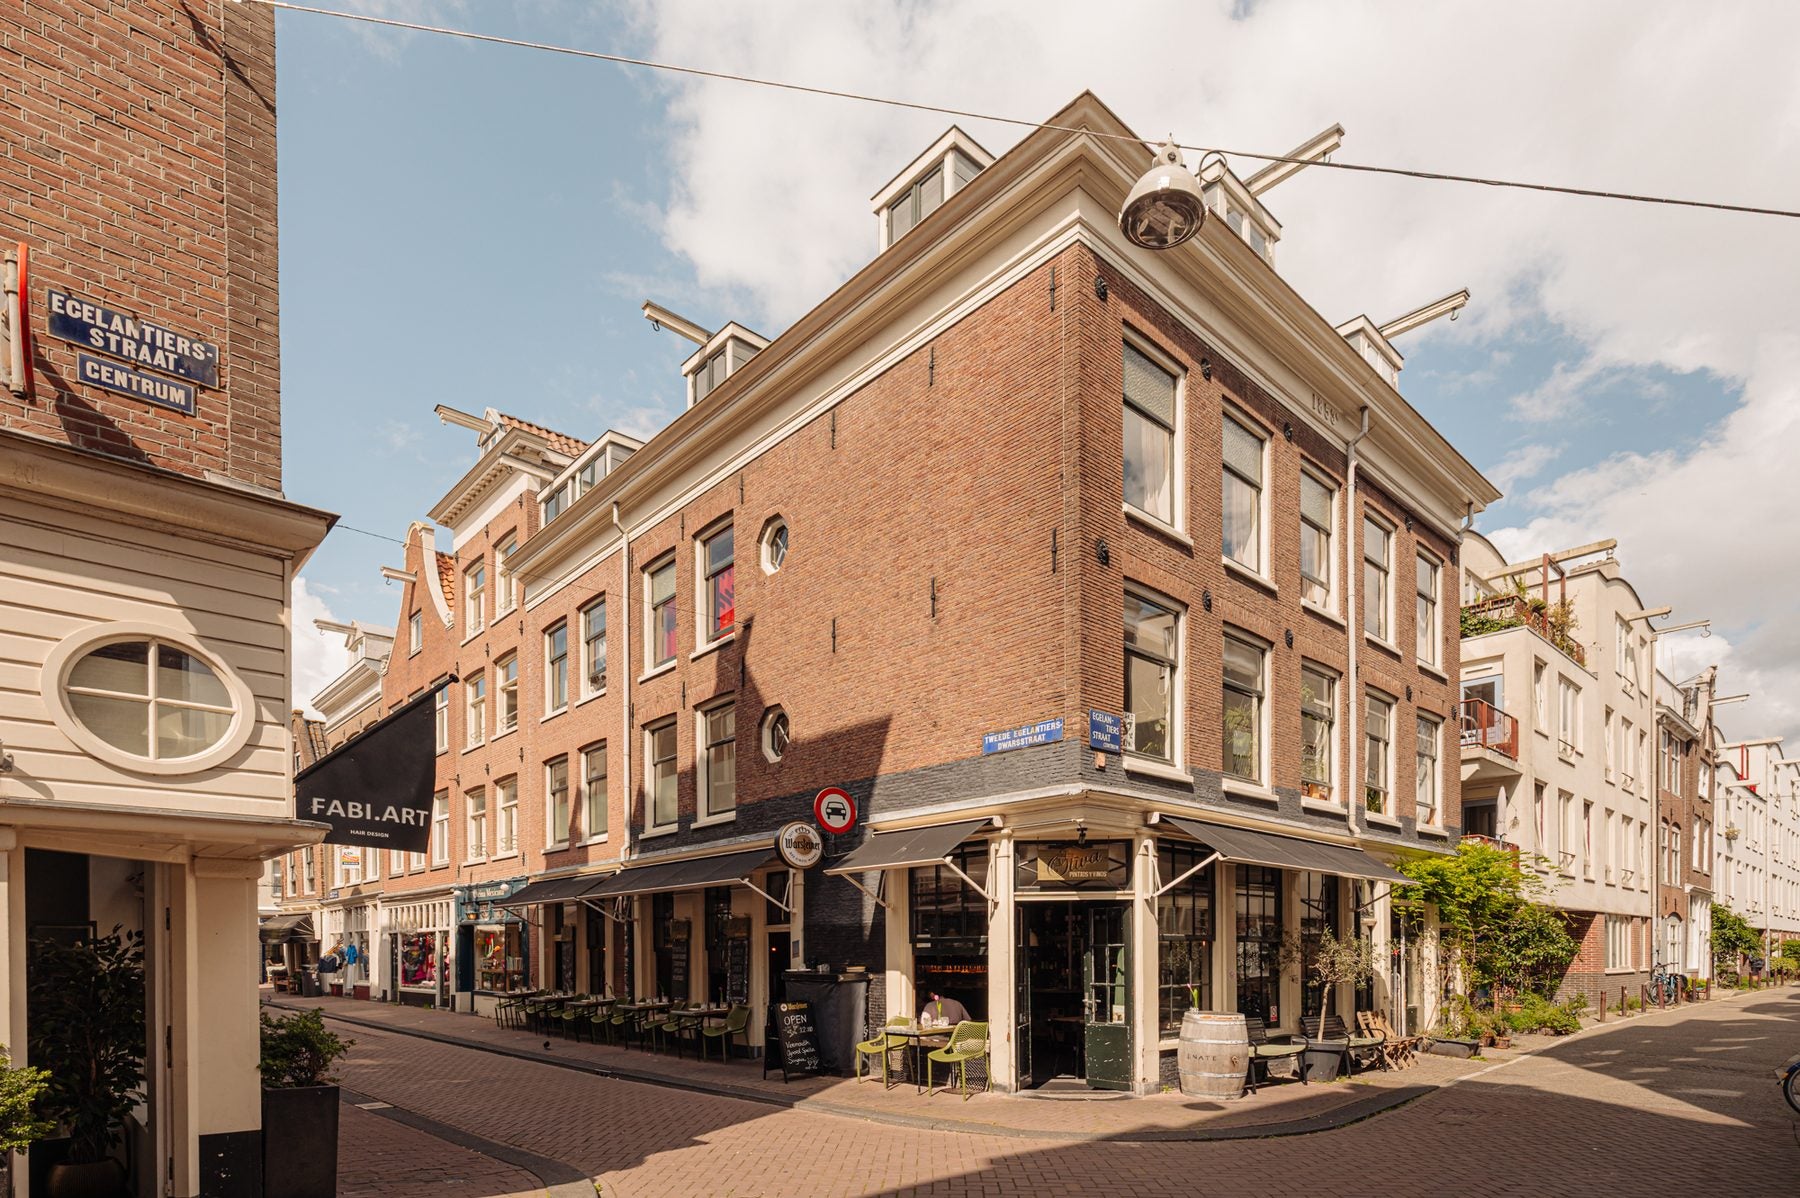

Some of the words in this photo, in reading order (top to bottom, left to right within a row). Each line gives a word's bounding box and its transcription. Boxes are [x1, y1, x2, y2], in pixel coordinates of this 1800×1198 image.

[85, 360, 186, 405] CENTRUM
[1092, 711, 1114, 724] EGELAN-
[1105, 724, 1120, 735] TIERS
[984, 732, 1011, 743] TWEEDE
[997, 734, 1046, 750] DWARSSTRAAT
[1092, 731, 1111, 742] STRAAT
[311, 797, 429, 827] FABI.ART
[784, 1014, 807, 1025] OPEN
